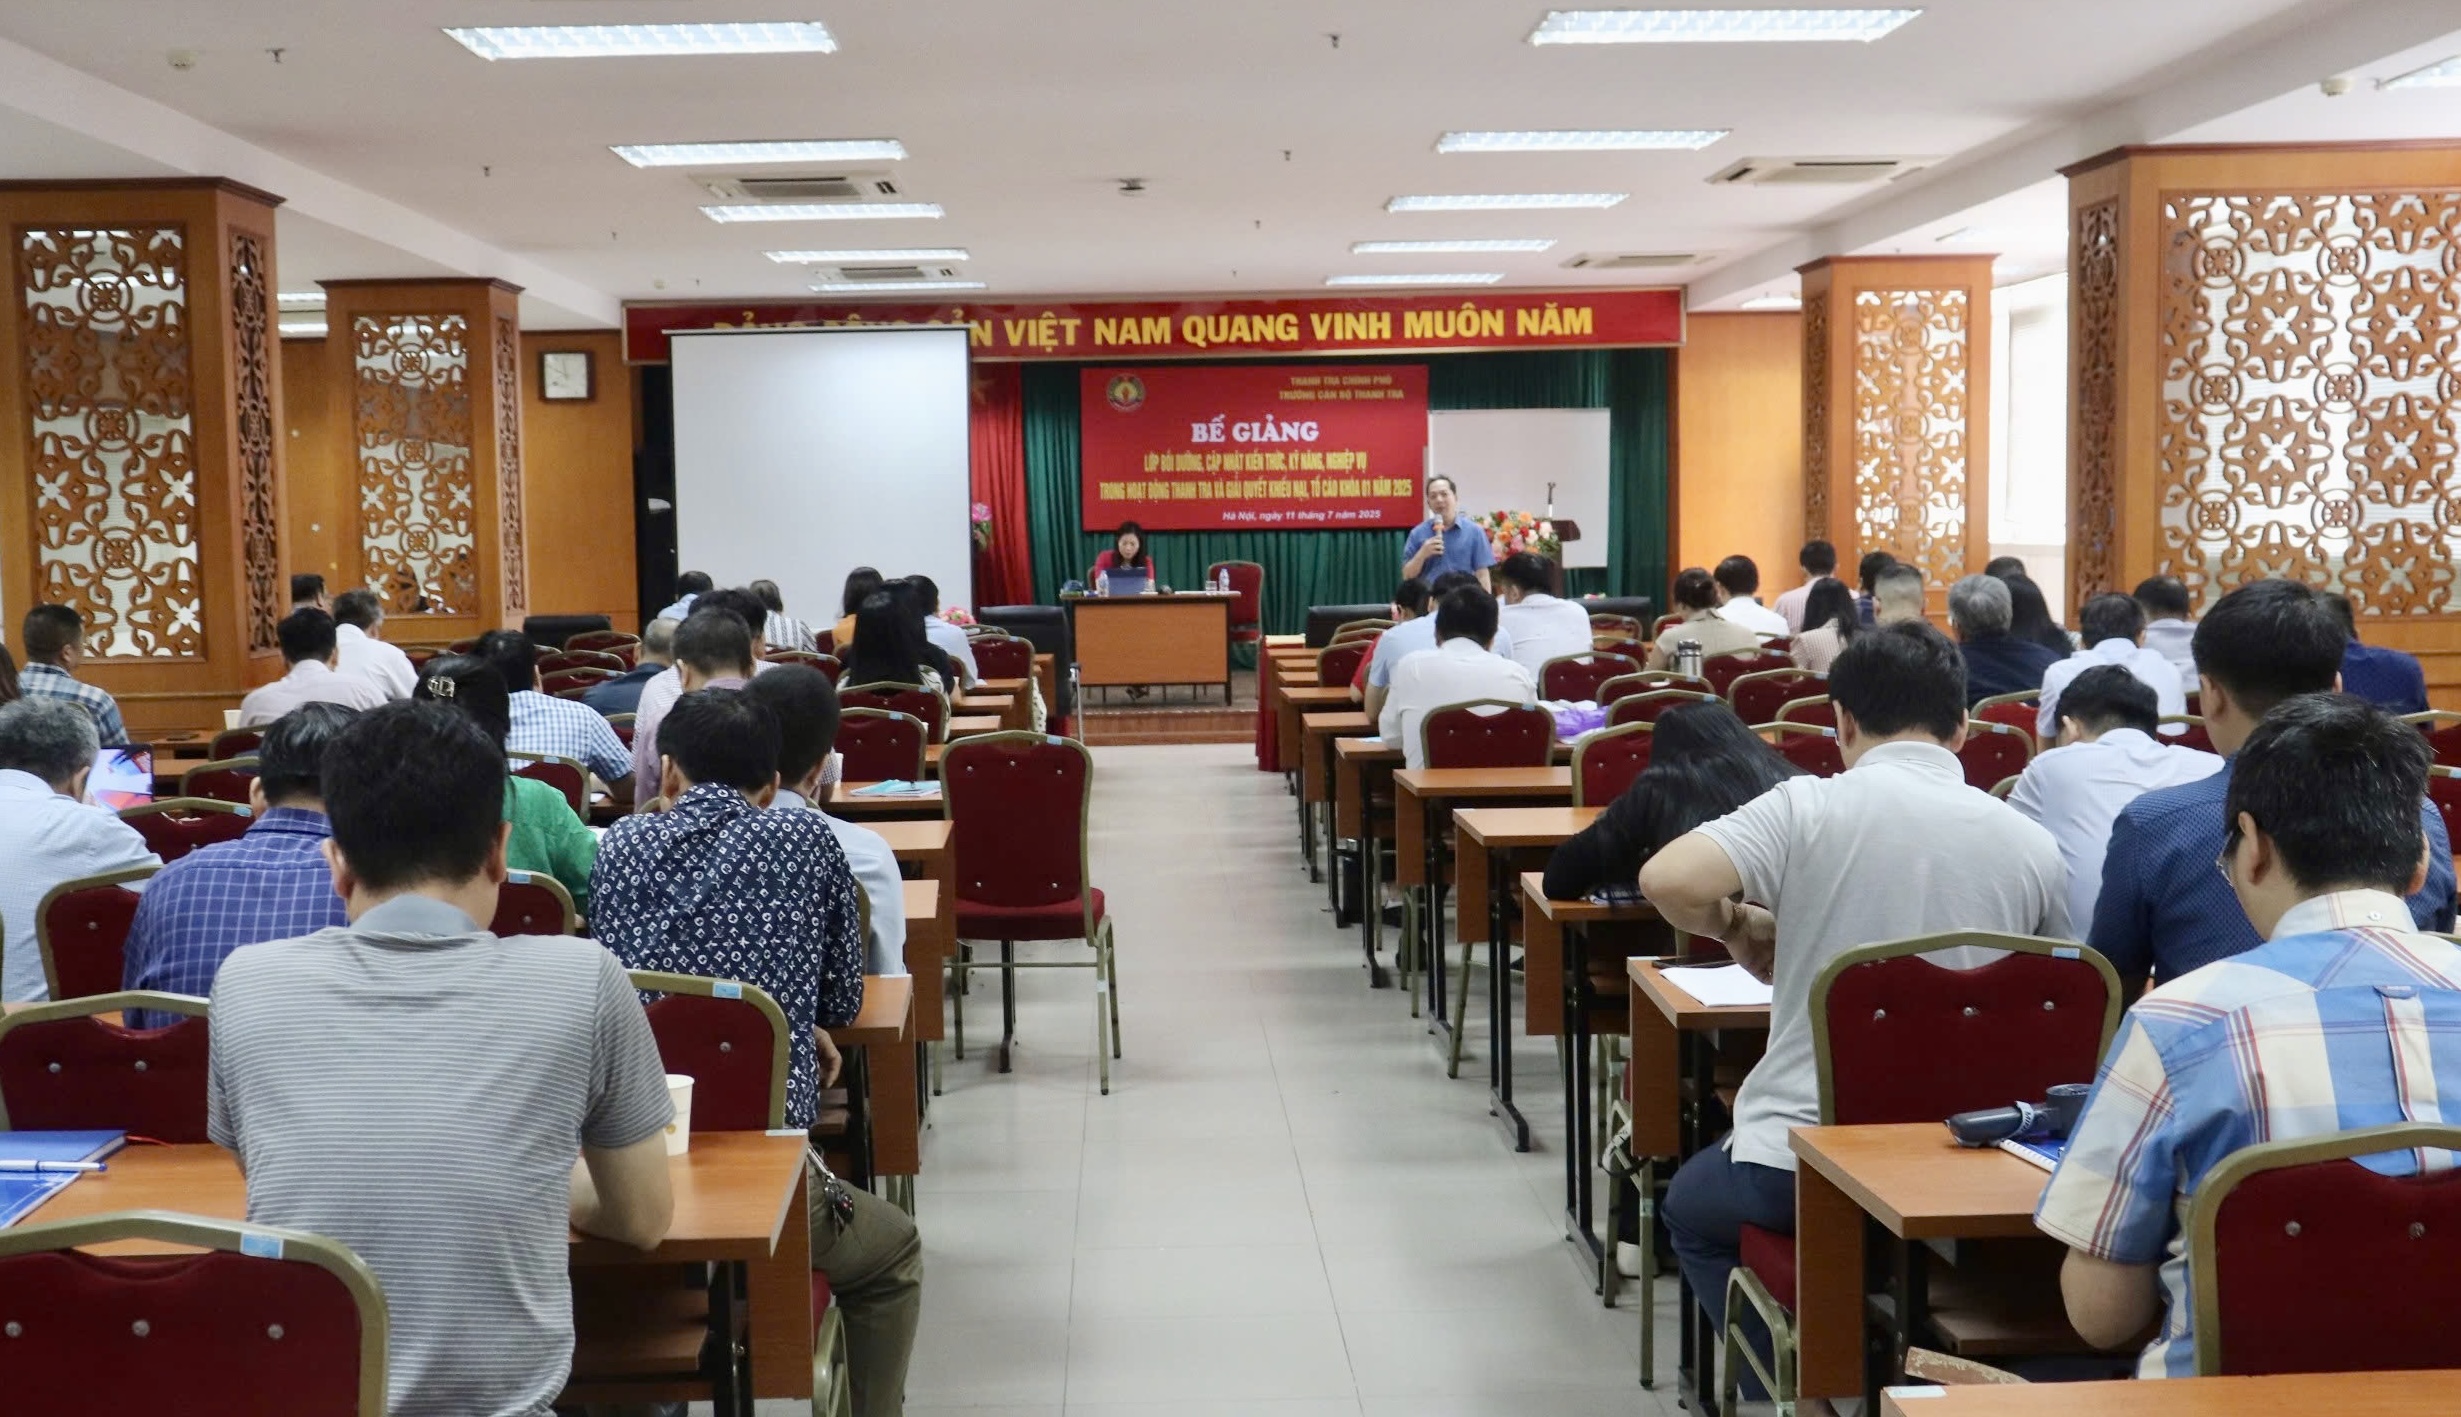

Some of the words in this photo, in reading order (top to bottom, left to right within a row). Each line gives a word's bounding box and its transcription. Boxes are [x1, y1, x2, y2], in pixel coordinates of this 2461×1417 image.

[1004, 312, 1082, 352] VIỆT
[1094, 316, 1171, 345] NAM
[1182, 313, 1299, 347] QUANG
[1310, 311, 1391, 340] VINH
[1403, 302, 1504, 339] MUÔN
[1516, 302, 1593, 336] NĂM
[1191, 413, 1226, 443] BẾ
[1232, 414, 1319, 443] GIẢNG
